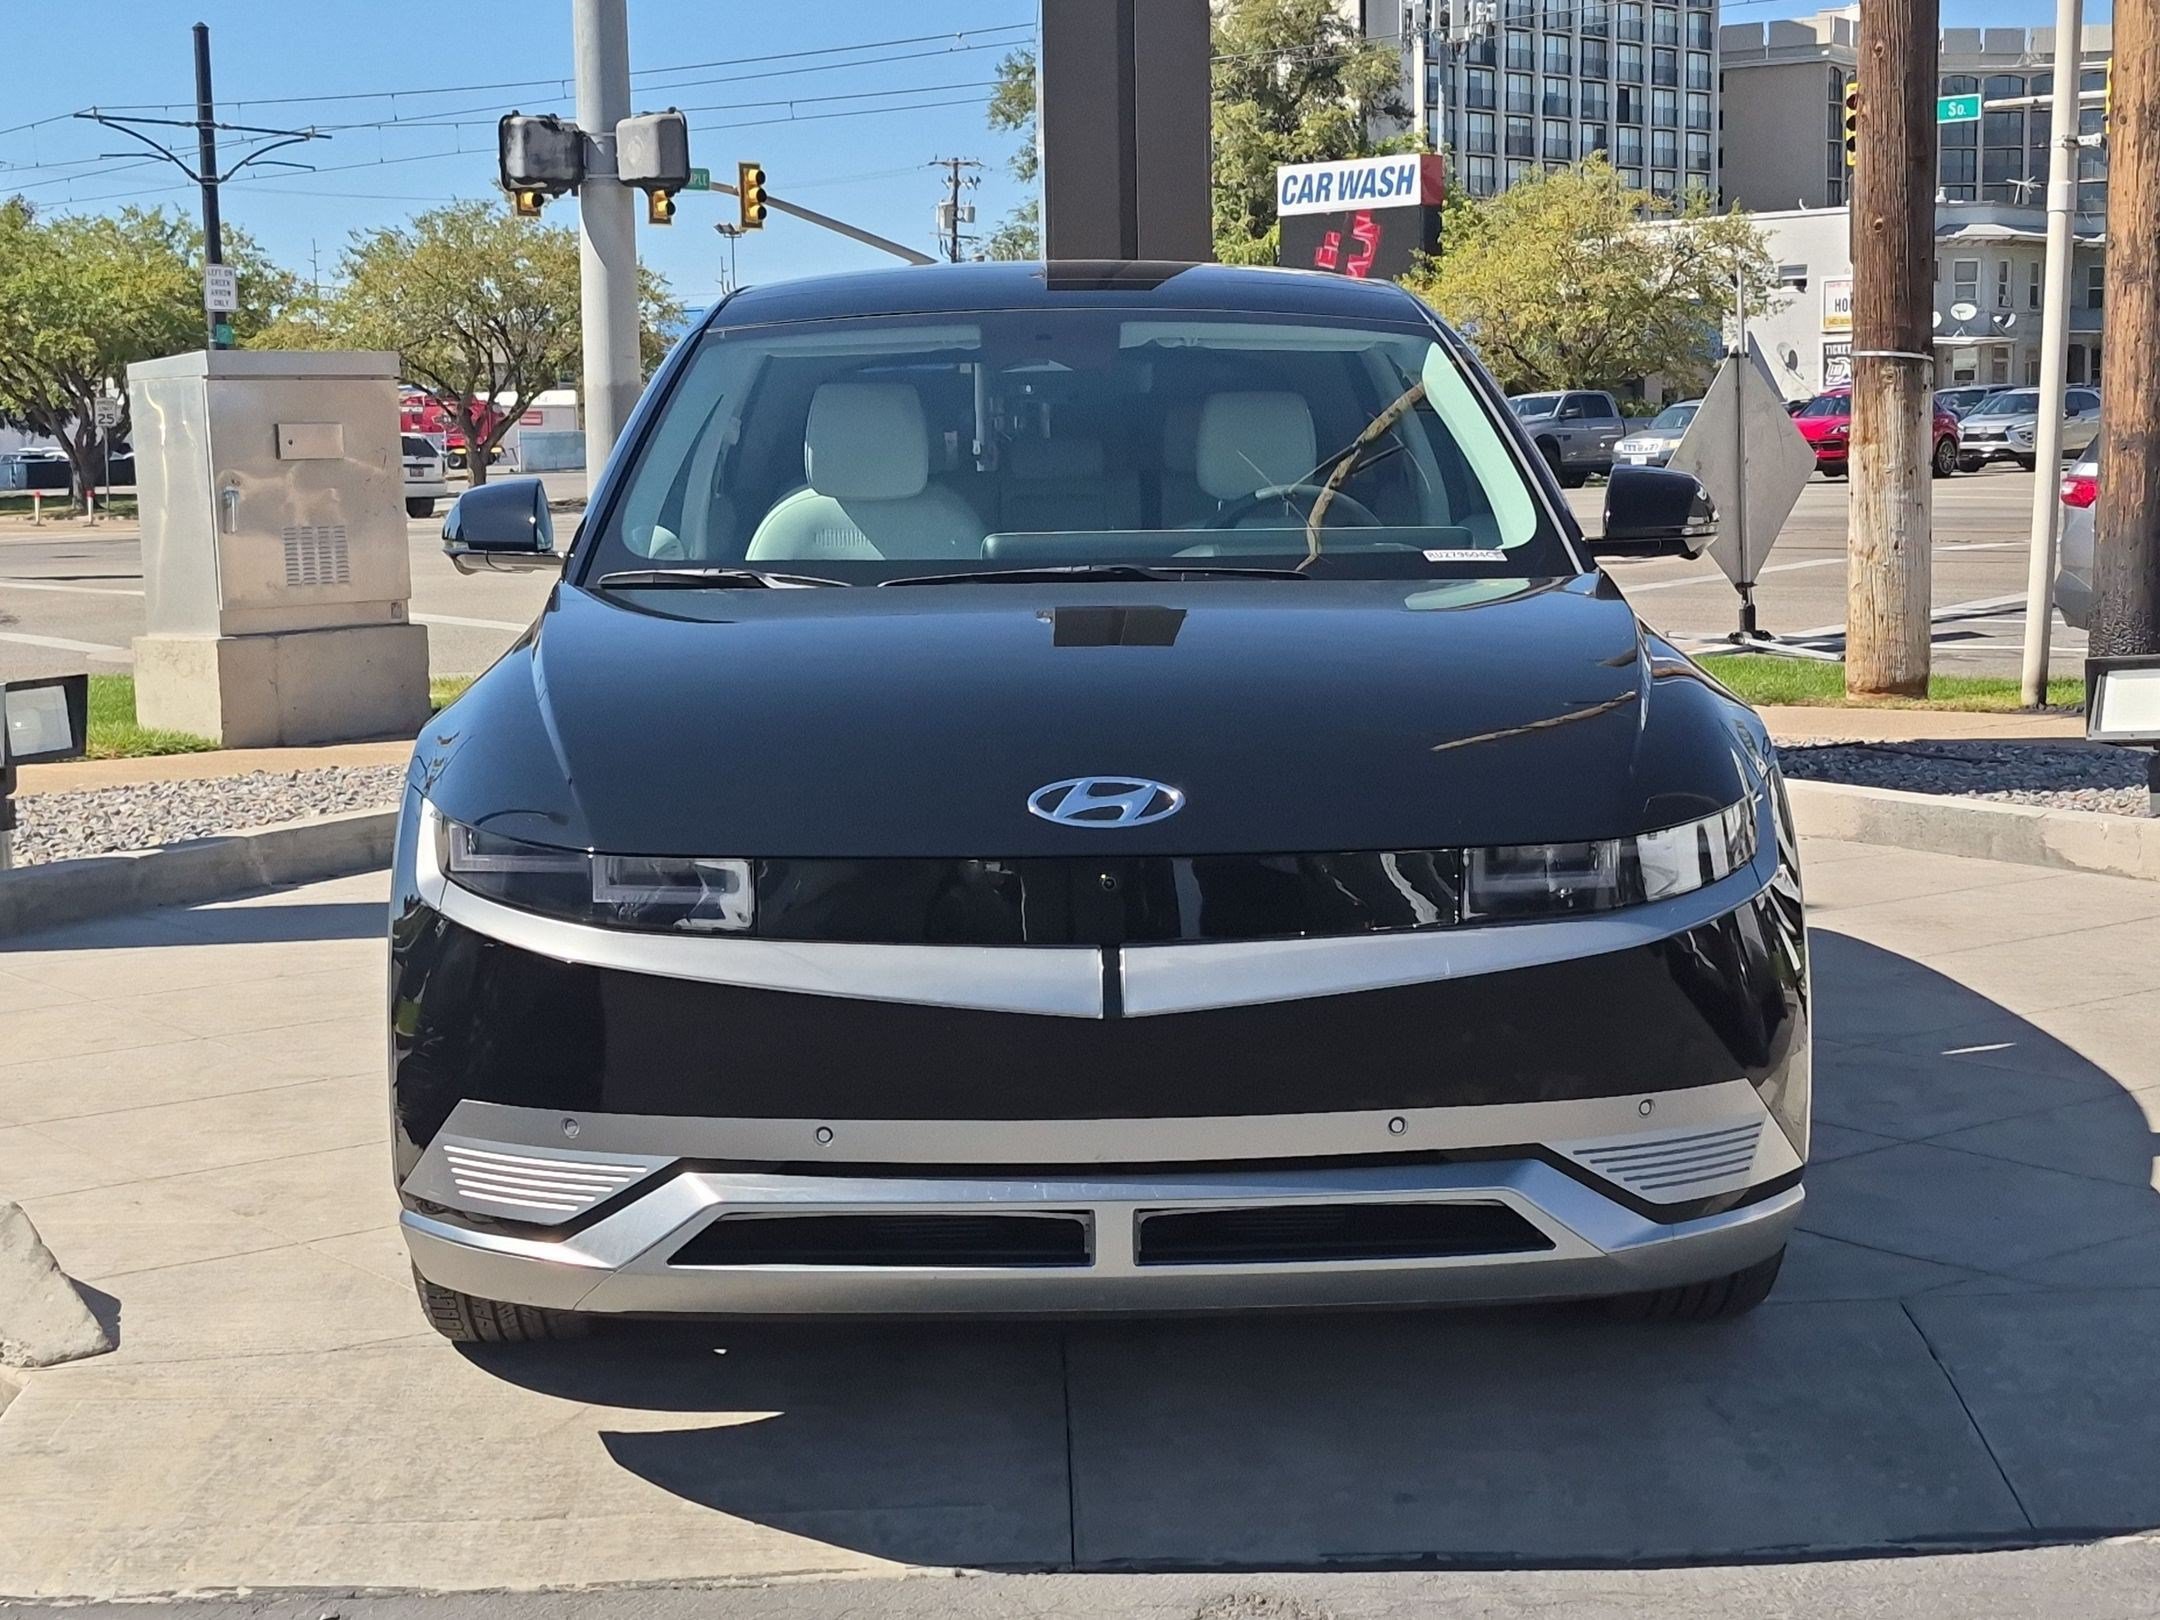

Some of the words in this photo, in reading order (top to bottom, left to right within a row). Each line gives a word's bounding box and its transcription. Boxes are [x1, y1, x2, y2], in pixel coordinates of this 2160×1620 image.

[1947, 101, 1967, 117] So.
[1281, 172, 1334, 206] CAR
[1338, 164, 1416, 201] WASH
[1834, 298, 1854, 312] HO
[97, 413, 115, 425] 25
